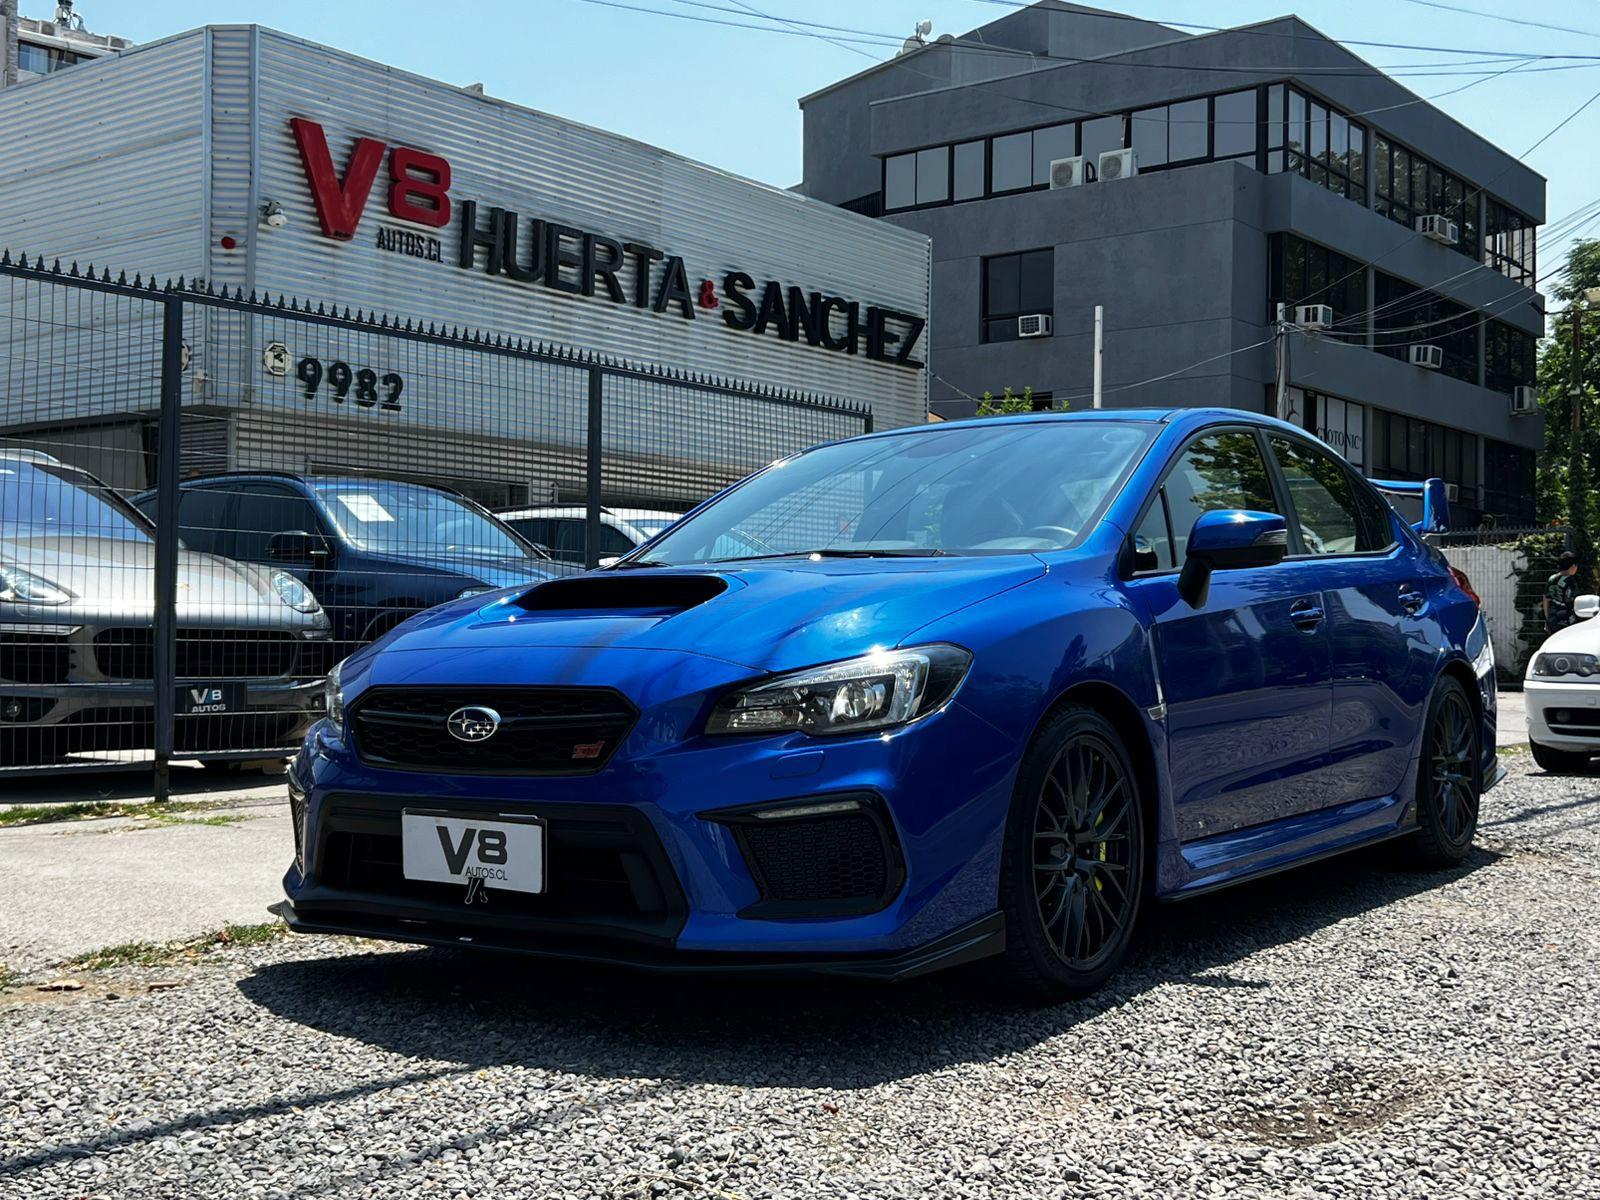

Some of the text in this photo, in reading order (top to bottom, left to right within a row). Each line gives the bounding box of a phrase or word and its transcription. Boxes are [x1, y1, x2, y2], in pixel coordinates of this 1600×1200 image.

[289, 116, 452, 241] V8
[376, 227, 444, 263] AUTOS.CL
[459, 200, 927, 369] HUERTA & SANCHEZ
[299, 357, 404, 411] 9982
[191, 688, 222, 705] V8
[436, 825, 508, 876] V8
[464, 865, 508, 881] AUTOS.CL
